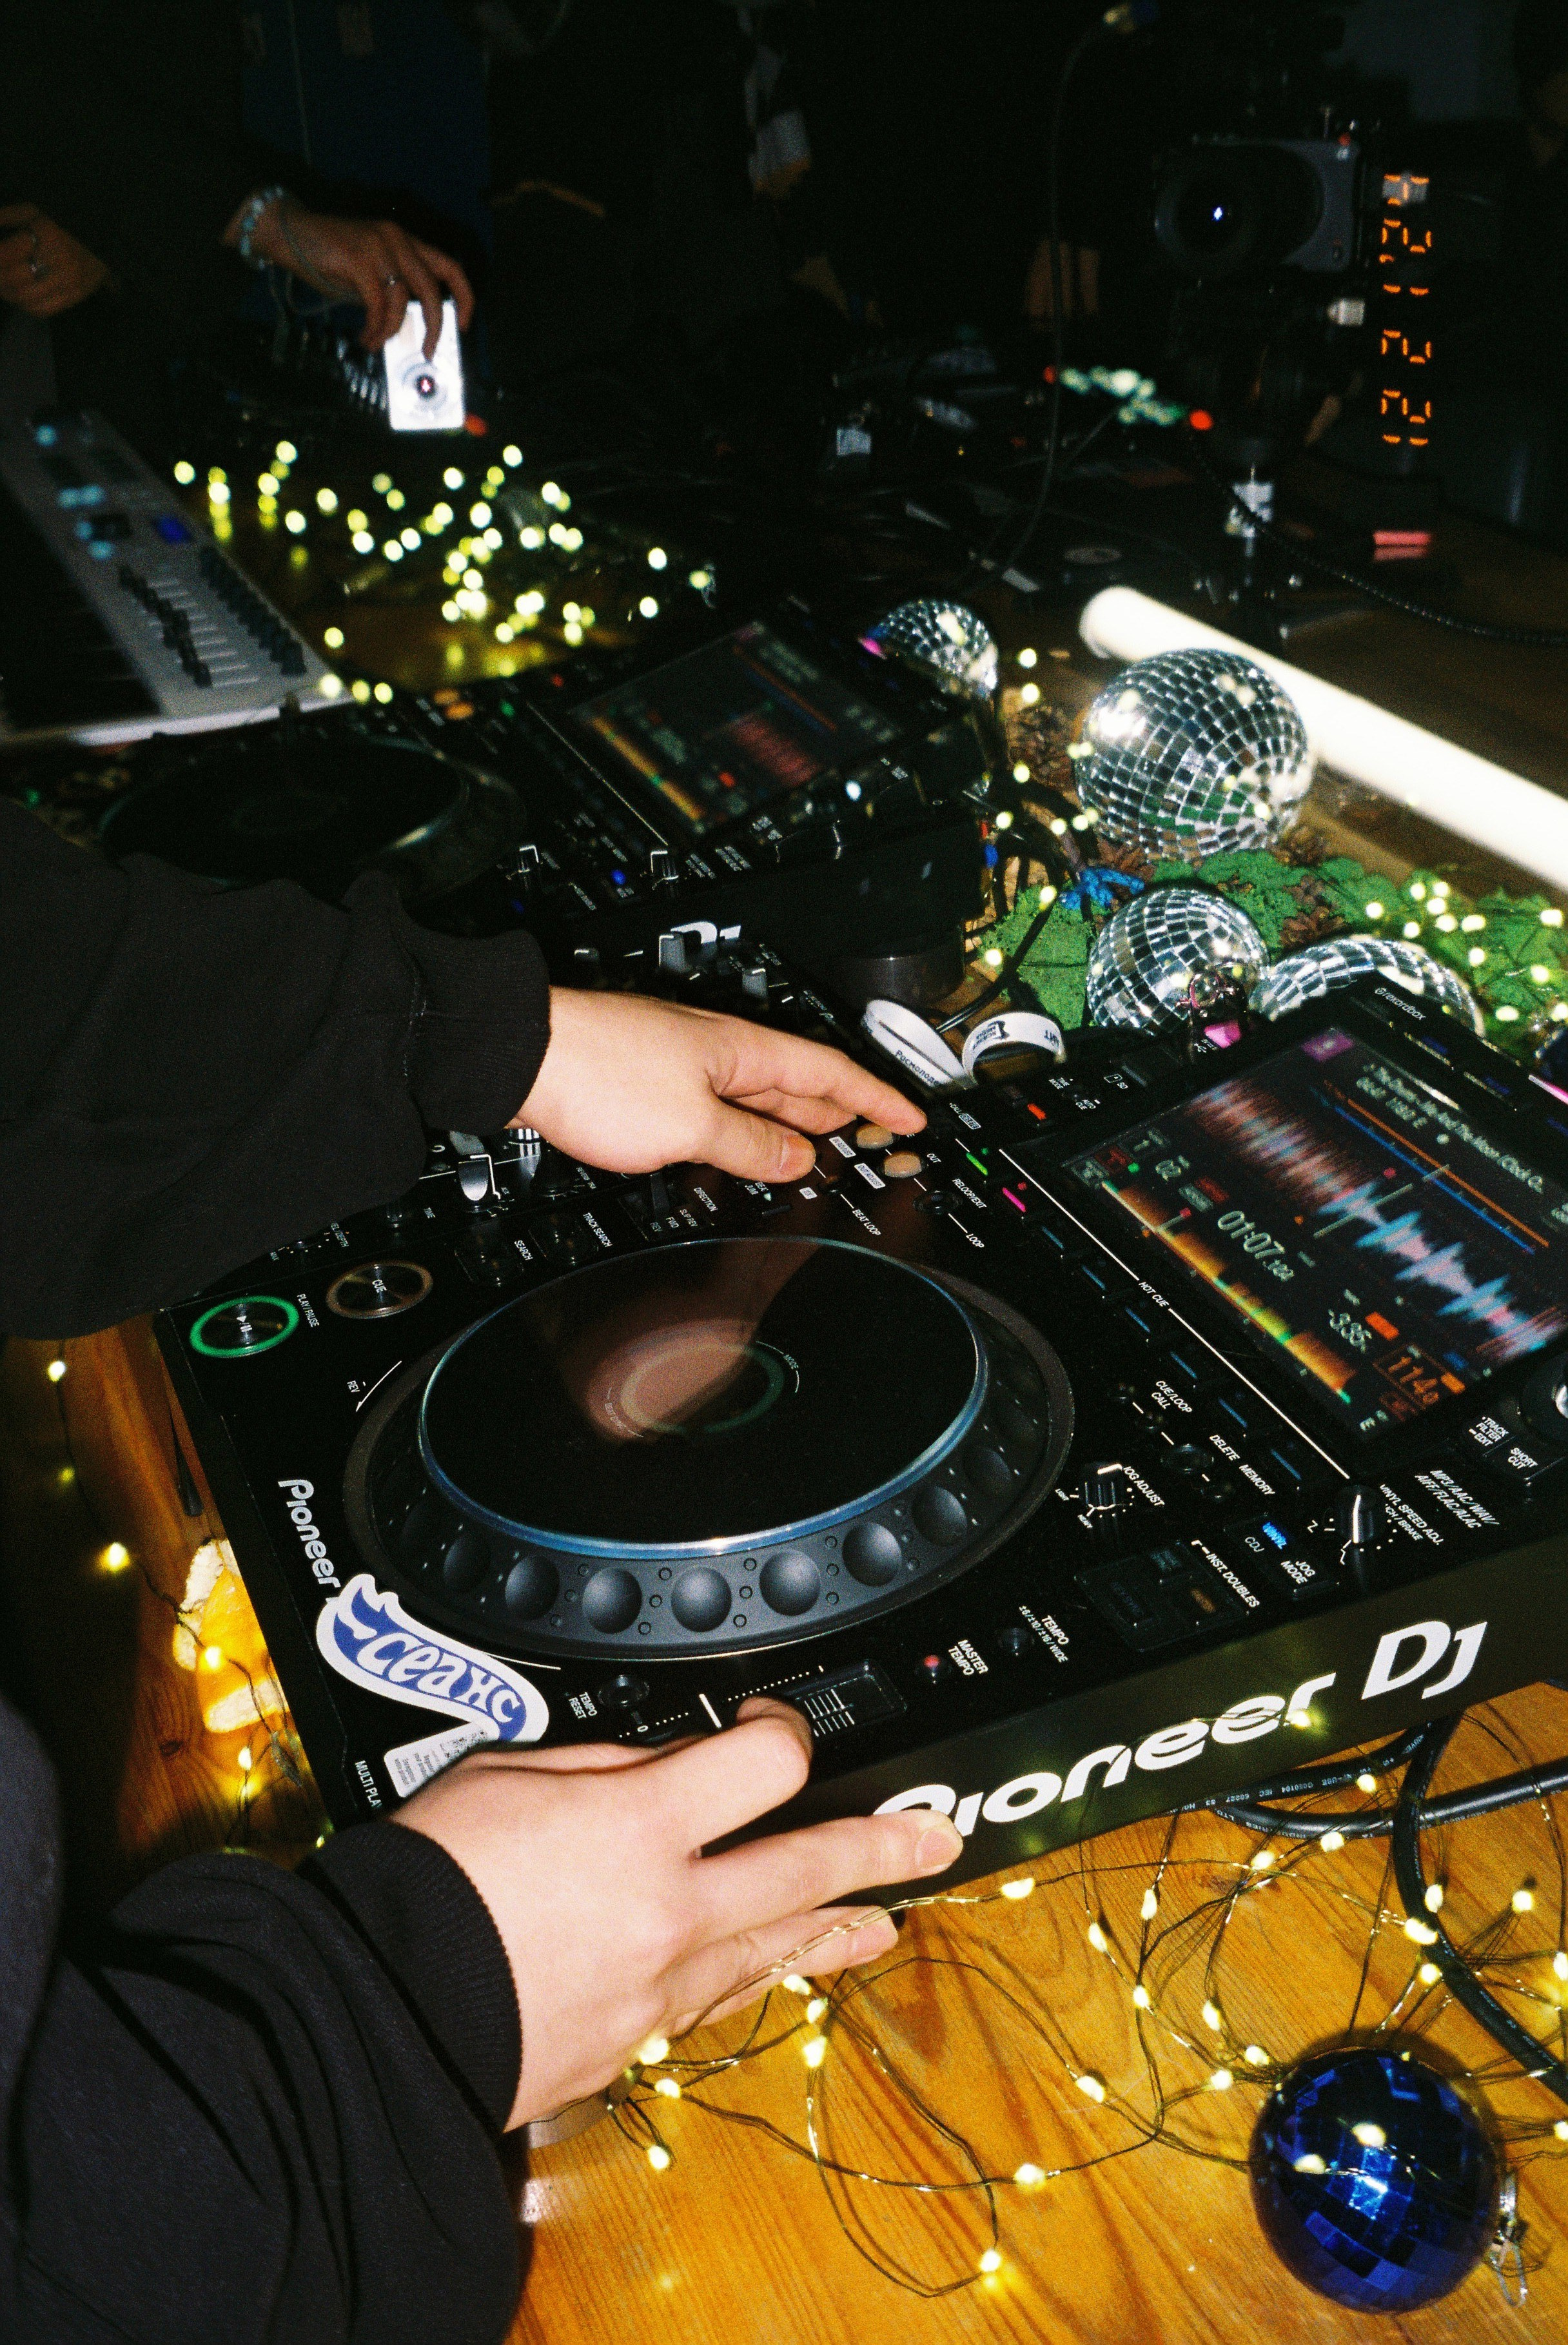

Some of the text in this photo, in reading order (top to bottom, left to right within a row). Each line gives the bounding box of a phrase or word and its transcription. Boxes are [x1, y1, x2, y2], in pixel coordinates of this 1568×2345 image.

[1383, 991, 1427, 1021] rekordbox
[926, 1153, 942, 1164] OUT
[693, 1186, 718, 1212] DIRECTION
[952, 1178, 988, 1209] RELOOP/EXIT
[582, 1212, 612, 1248] TRACK SEARCH
[852, 1208, 881, 1237] BEAT LOOP
[513, 1239, 534, 1262] SEARCH
[965, 1233, 985, 1250] LOOP
[371, 1278, 387, 1294] CUE
[1138, 1281, 1170, 1308] HOT CUE
[296, 1293, 320, 1329] PLAY/PAUSE
[346, 1379, 361, 1394] REV
[1155, 1379, 1193, 1414] CUE/LOOP
[1151, 1391, 1170, 1411] CALL
[1473, 1431, 1494, 1447] EDIT
[1475, 1422, 1502, 1443] FILTER
[1485, 1417, 1510, 1437] TRACK
[1209, 1434, 1241, 1462] DELETE
[1510, 1447, 1539, 1469] SHORT
[1507, 1455, 1529, 1470] CUT
[1135, 1478, 1165, 1507] ADJUST
[1239, 1464, 1276, 1496] MEMORY
[1380, 1483, 1445, 1546] VINYL SPEED ADJ.
[1414, 1475, 1482, 1529] AIFF/FLAC/ALAC
[277, 1478, 341, 1589] Pioneer
[1398, 1519, 1424, 1542] BRAKE
[1244, 1536, 1265, 1553] CDJ
[1280, 1560, 1309, 1585] MODE
[1295, 1560, 1316, 1577] JOG
[1222, 1572, 1260, 1609] DOUBLES
[1041, 1614, 1070, 1646] TEMPO
[947, 1645, 975, 1676] TEMPO
[957, 1640, 988, 1674] MASTER
[1361, 1620, 1488, 1700] DJ
[568, 1696, 587, 1721] RESET
[578, 1691, 598, 1718] TEMPO
[355, 1760, 375, 1789] MULTI
